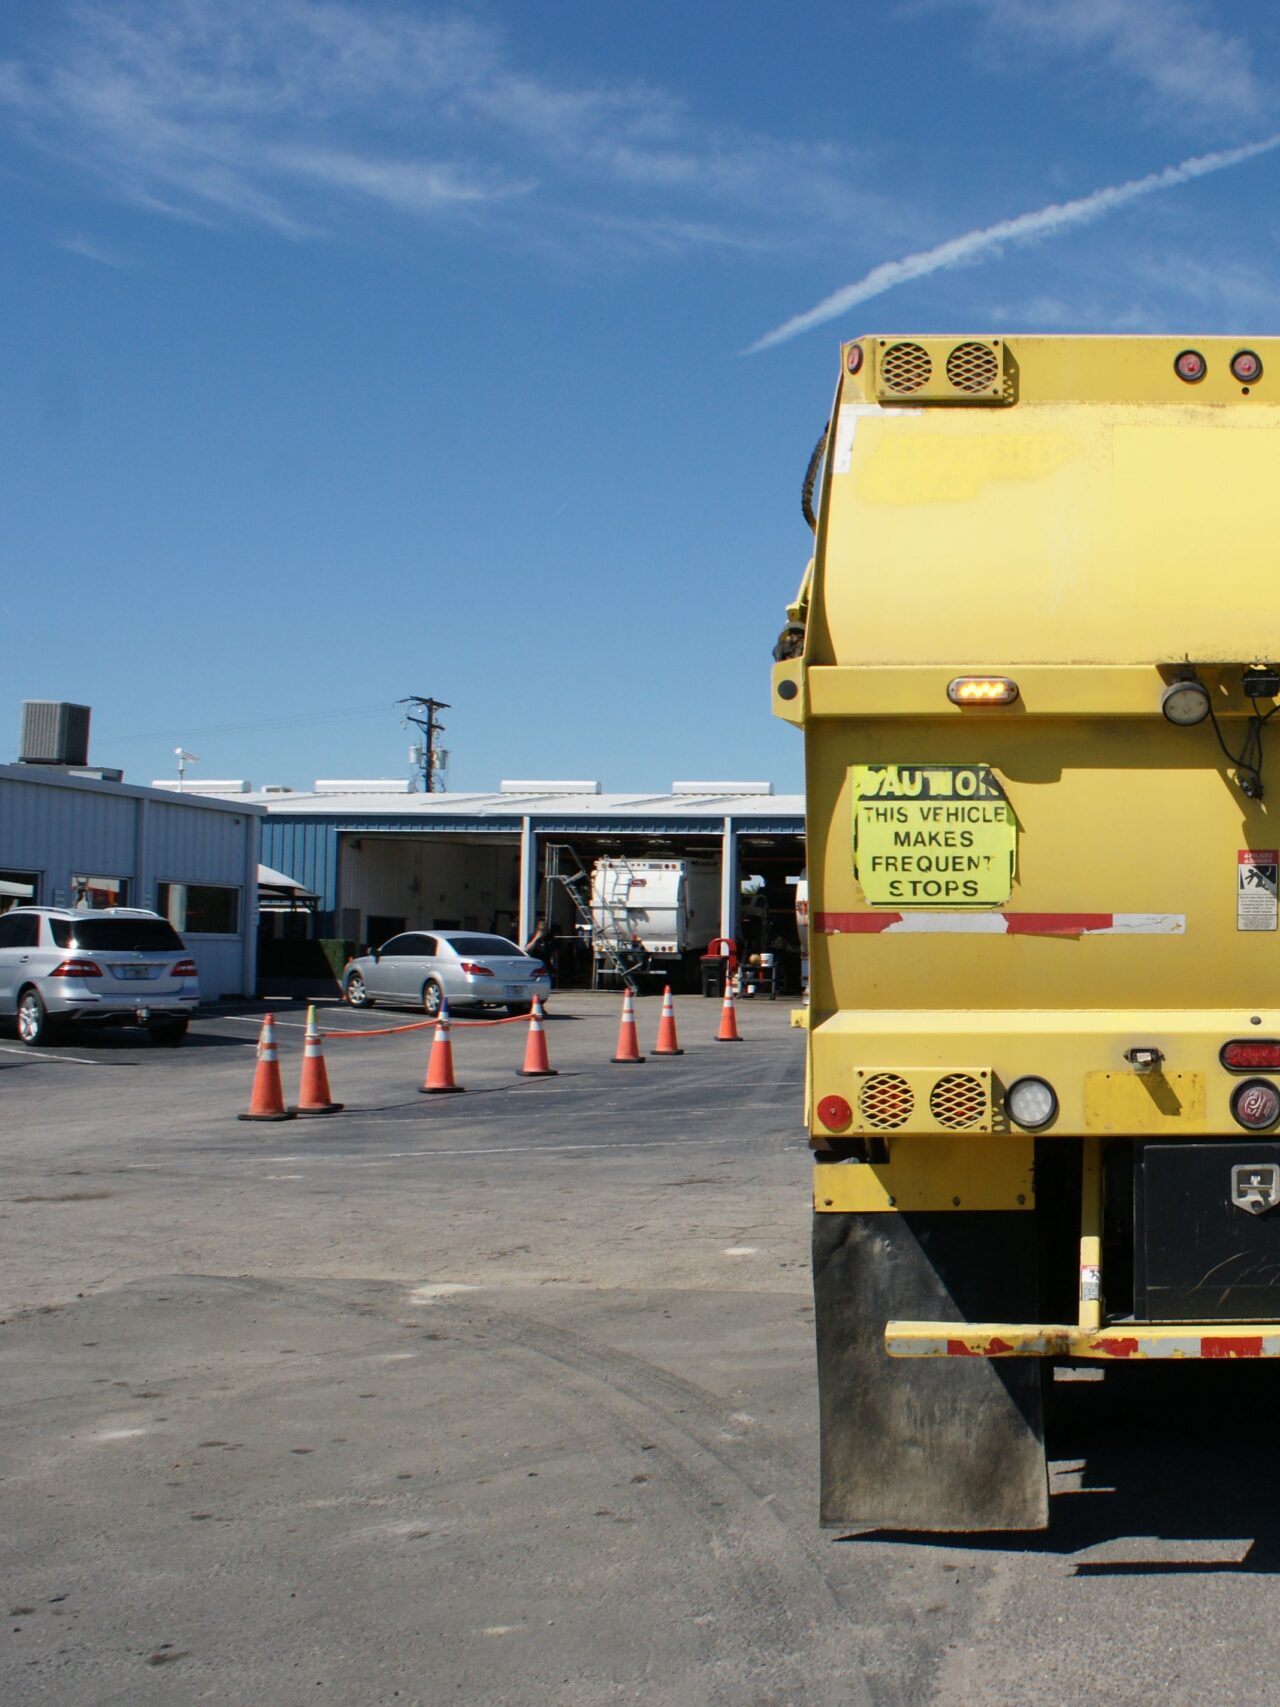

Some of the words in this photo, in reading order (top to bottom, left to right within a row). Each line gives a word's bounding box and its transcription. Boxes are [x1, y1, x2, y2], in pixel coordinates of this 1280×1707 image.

[864, 806, 908, 823] THIS
[919, 806, 1006, 823] VEHICLE
[894, 830, 974, 848] MAKES
[871, 855, 993, 872] FREQUENT
[889, 880, 979, 897] STOPS
